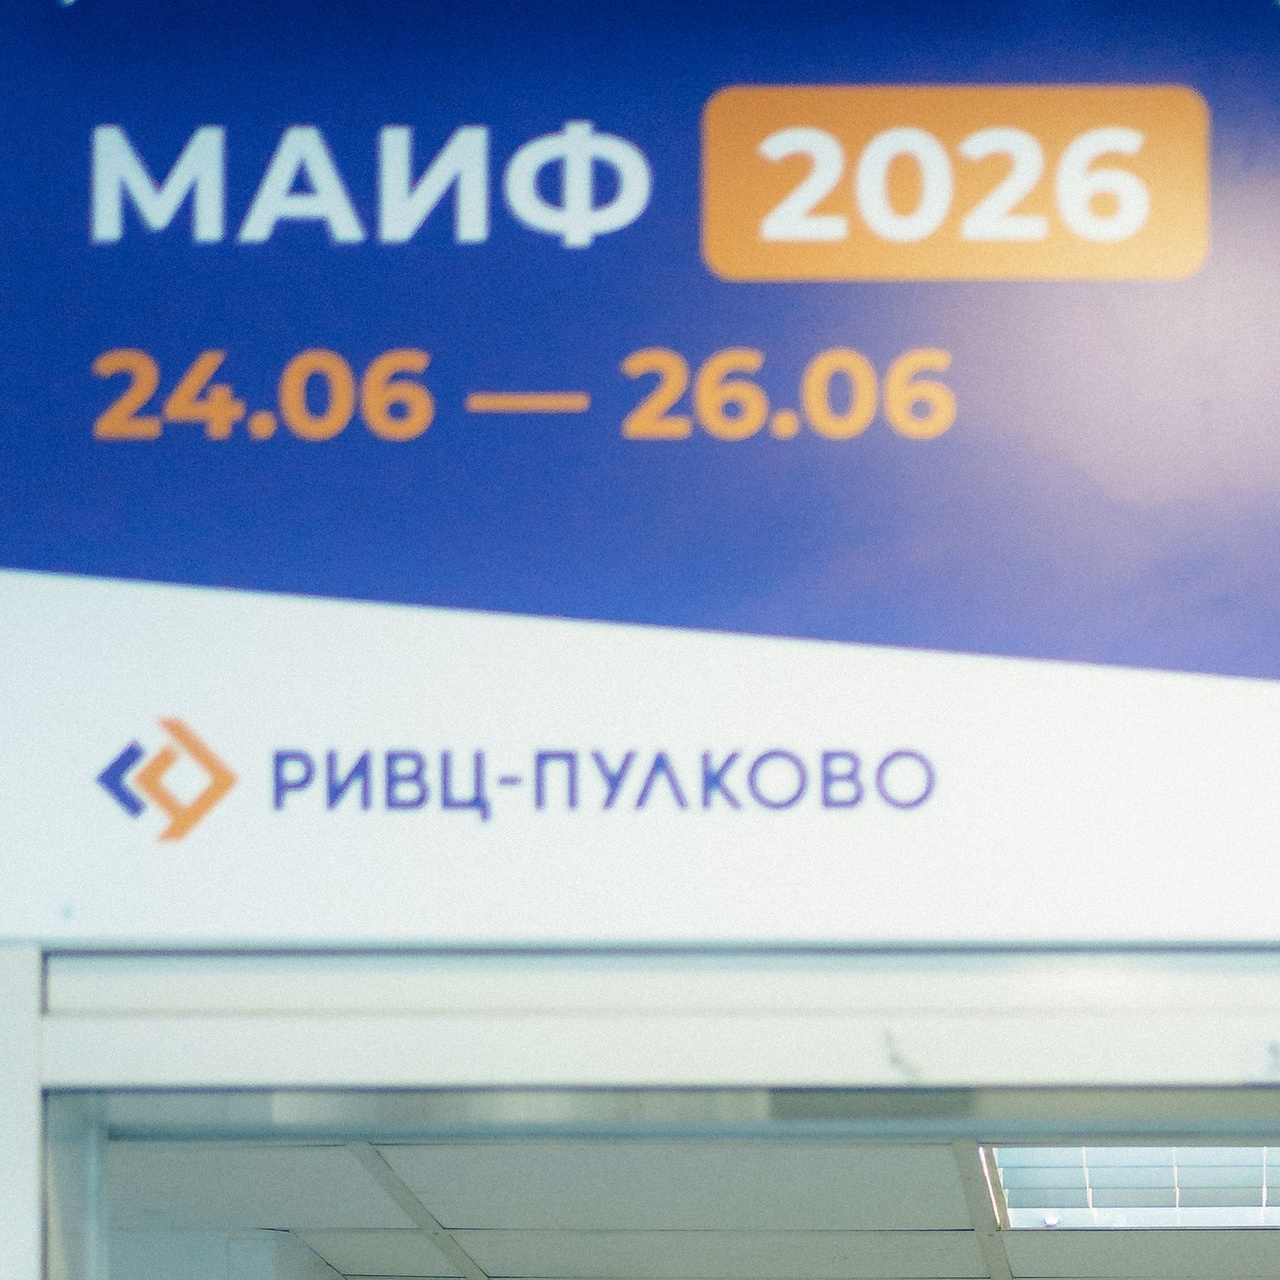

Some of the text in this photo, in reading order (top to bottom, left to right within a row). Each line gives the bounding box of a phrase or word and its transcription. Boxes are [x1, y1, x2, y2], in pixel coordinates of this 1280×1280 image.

[89, 121, 1152, 248] МАИФ 2026
[91, 348, 436, 441] 24.06
[619, 347, 958, 441] 26.06
[271, 748, 937, 823] РИВЦ-ПУЛКОВО
